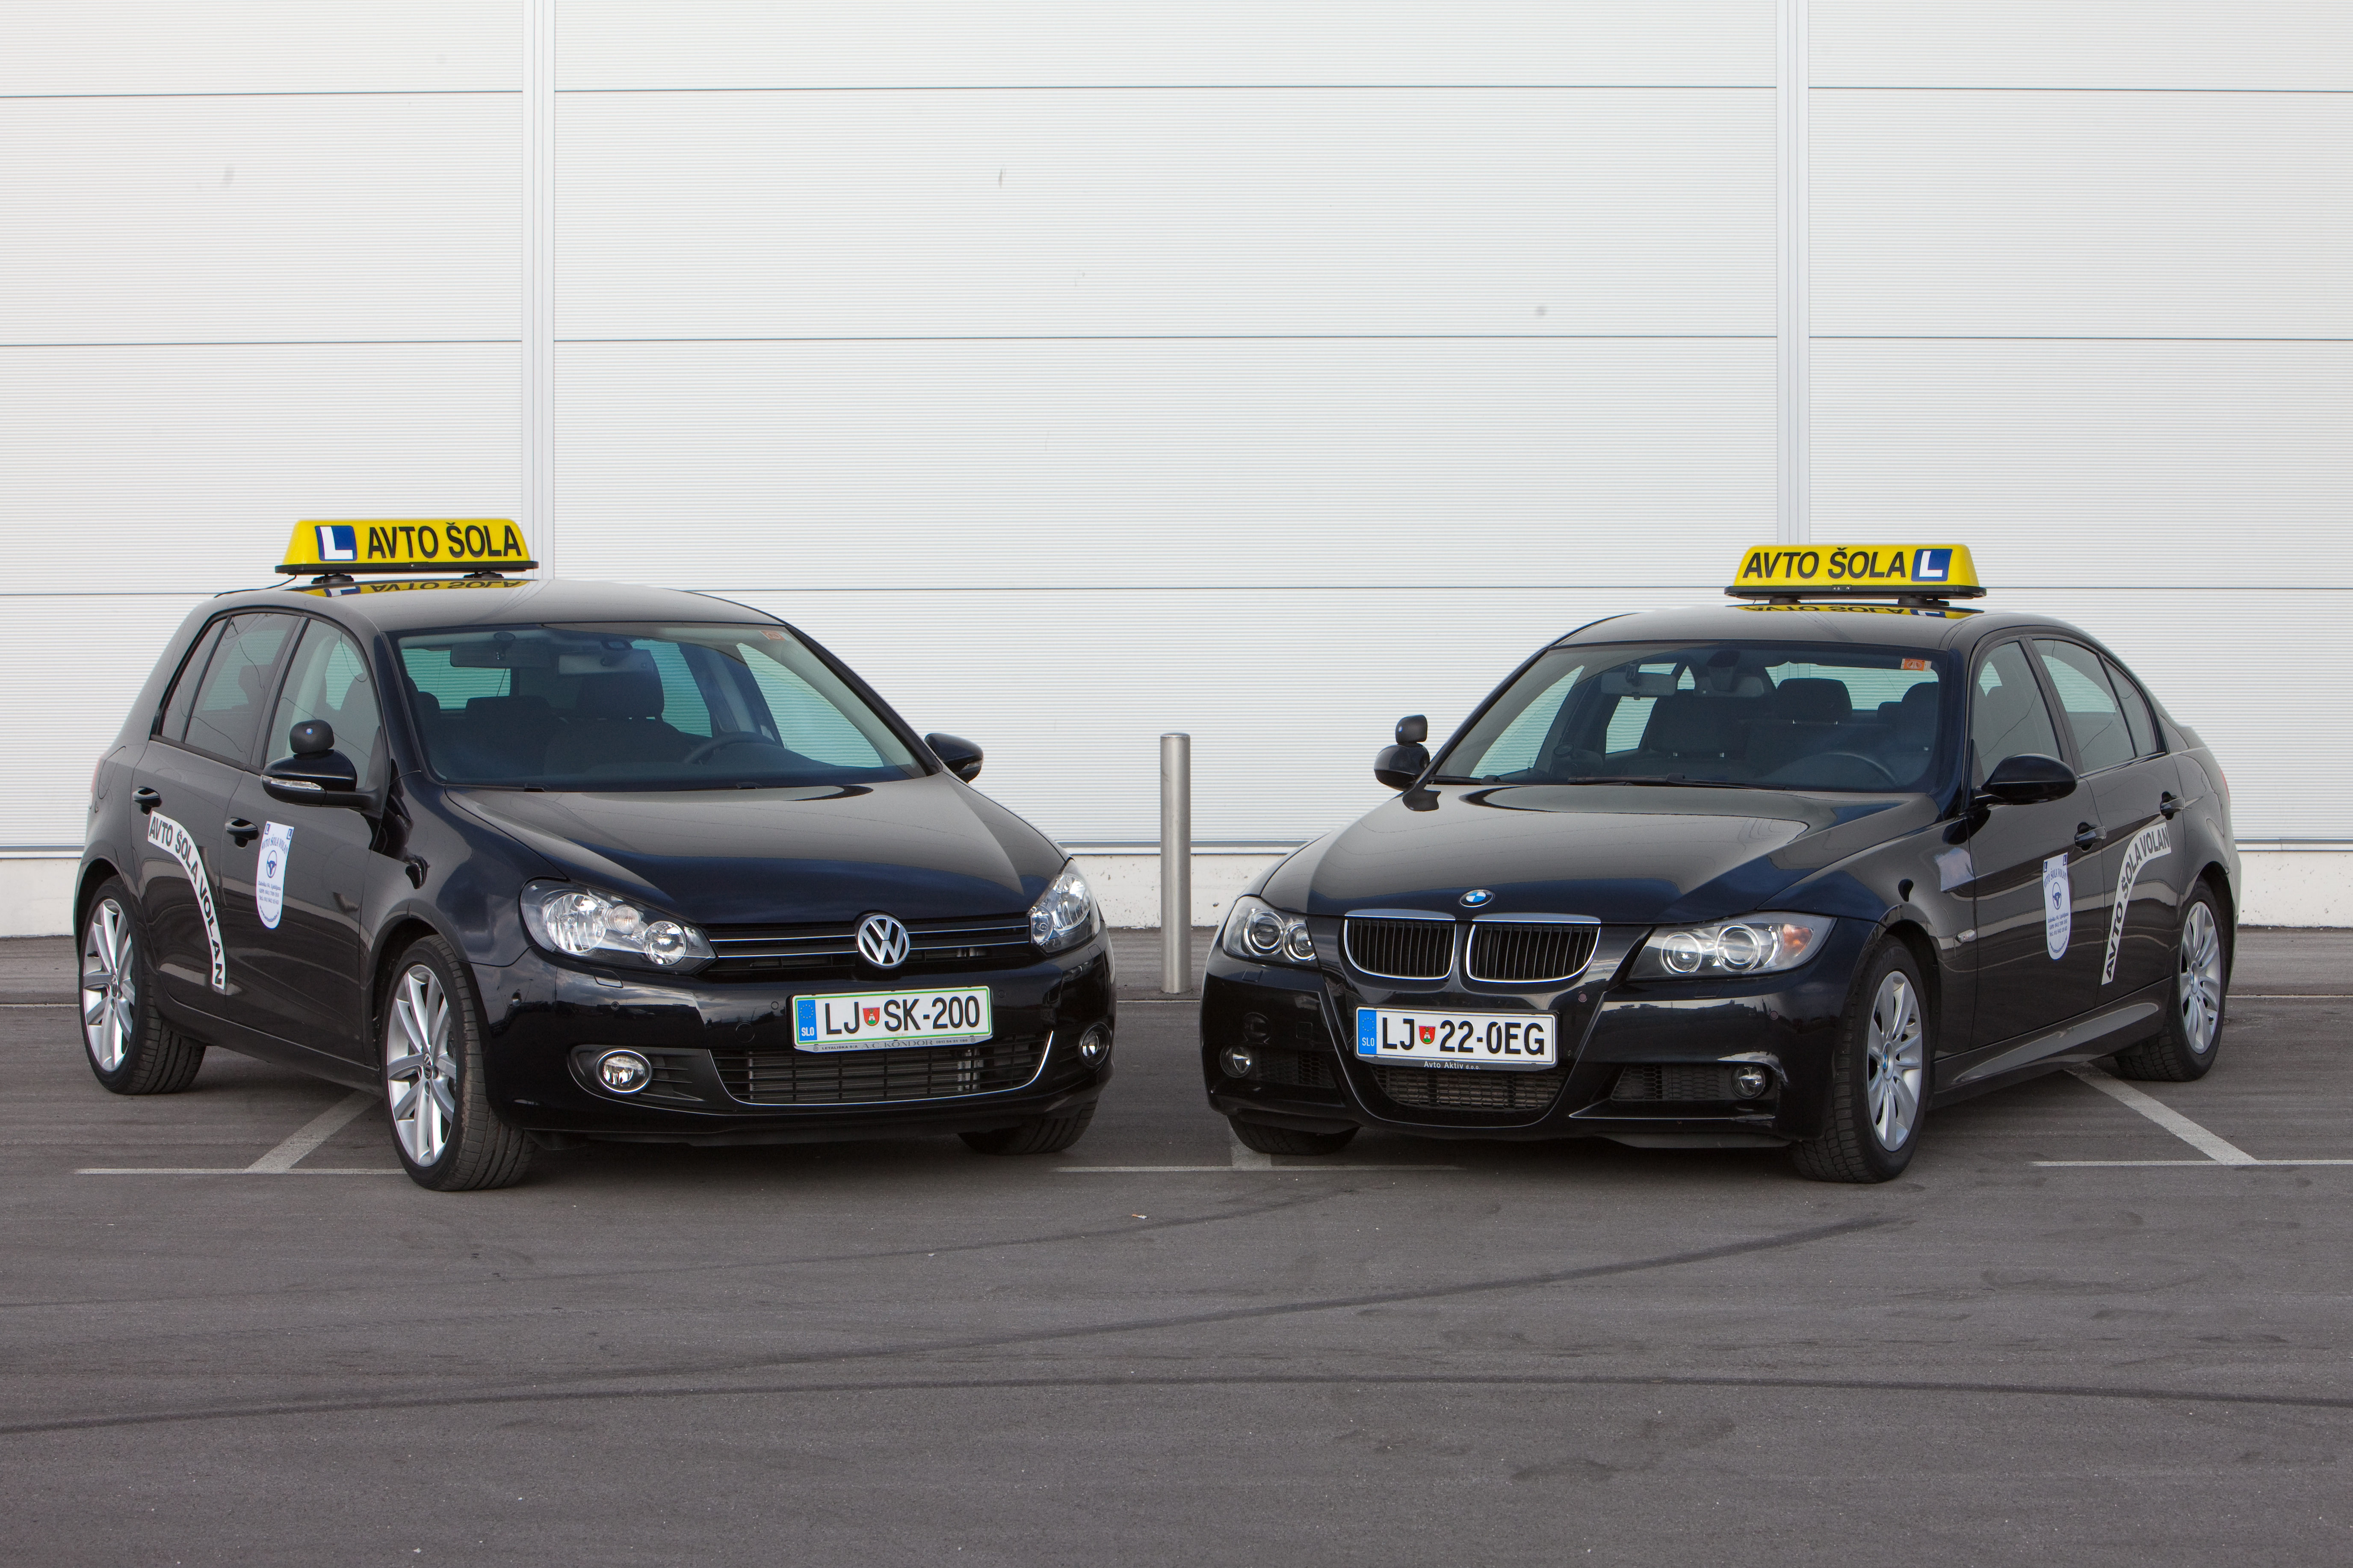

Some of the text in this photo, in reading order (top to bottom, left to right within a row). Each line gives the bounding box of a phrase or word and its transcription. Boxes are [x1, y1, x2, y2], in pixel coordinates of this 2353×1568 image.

[319, 522, 522, 560] L AVTO ŠOLA
[1742, 547, 1943, 579] AVTO ŠOLA L
[265, 824, 269, 834] L
[287, 829, 292, 839] L
[261, 834, 288, 857] AVTO ŠOLA VOLAN
[2044, 862, 2047, 872] L
[2063, 855, 2066, 865] L
[2057, 868, 2067, 882] VOLAN
[149, 816, 223, 985] AVTO ŠOLA VOLAN
[2106, 827, 2170, 980] AVTO ŠOLA VOLAN
[825, 995, 980, 1034] LJ SK-200
[801, 1027, 815, 1037] SLO
[1382, 1017, 1544, 1055] LJ 22-0EG
[1362, 1037, 1375, 1046] SLO
